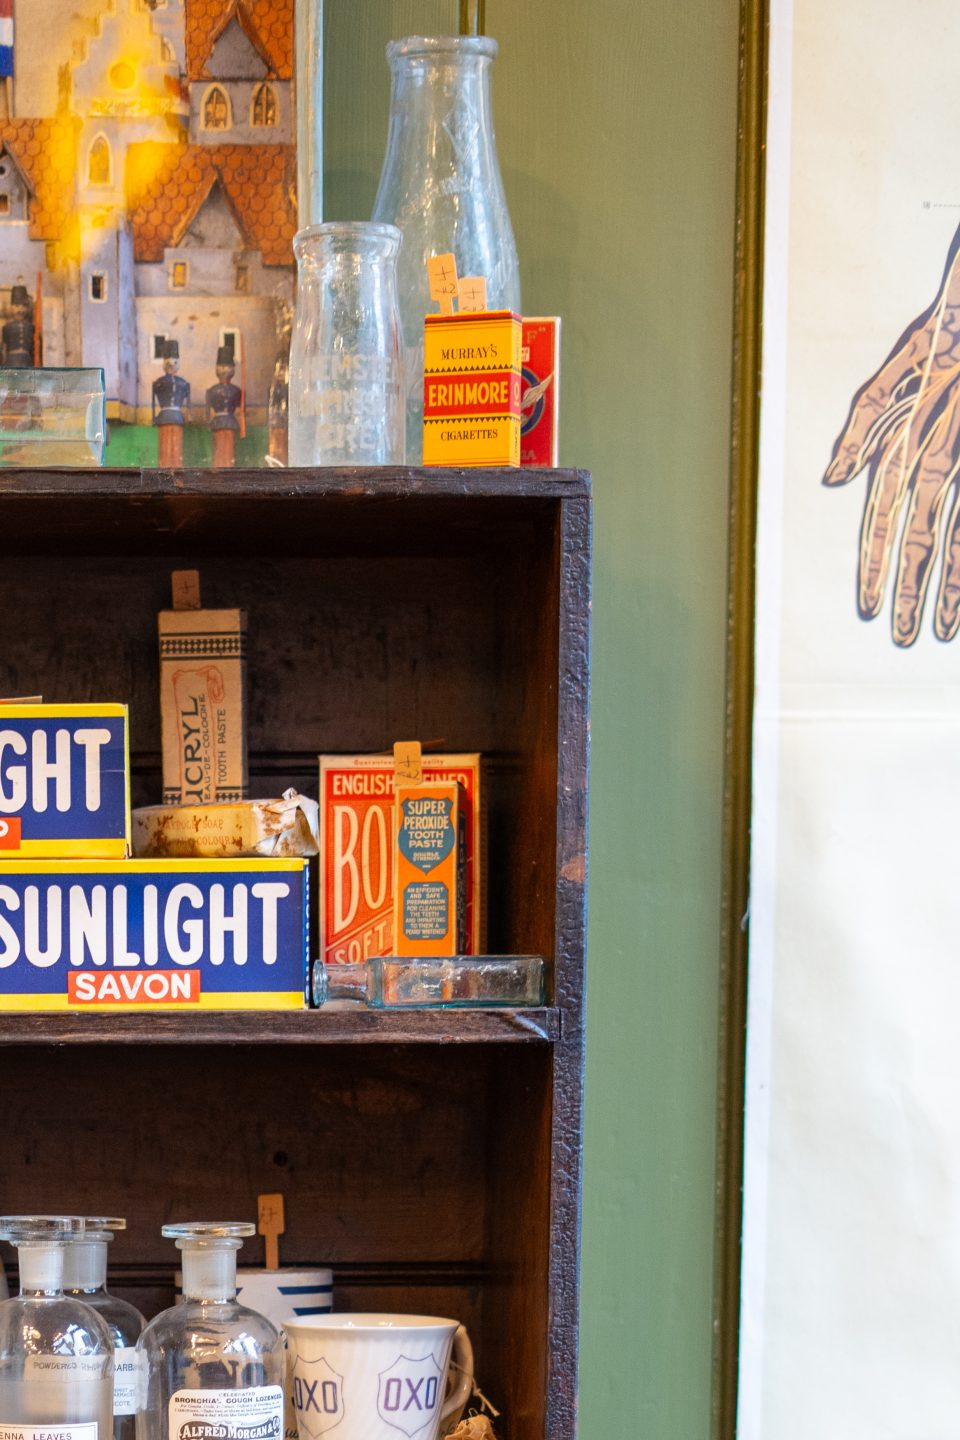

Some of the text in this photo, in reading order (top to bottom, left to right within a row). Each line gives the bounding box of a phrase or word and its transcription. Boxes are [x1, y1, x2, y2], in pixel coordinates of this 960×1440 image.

[441, 344, 498, 360] MURRAY'S
[428, 381, 509, 407] ERINMORE
[440, 429, 498, 441] CIGARETTES
[217, 708, 227, 784] TOOTH PASTE
[333, 774, 395, 796] ENGLISH
[408, 801, 445, 815] SUPER
[404, 816, 449, 829] PEROXIDE
[408, 831, 444, 839] TOOTH
[409, 840, 443, 848] PASTE
[75, 972, 192, 1001] SAVON
[292, 1377, 338, 1414] OXO
[383, 1376, 438, 1412] OXO
[33, 1432, 72, 1440] LEAVES
[182, 1425, 226, 1439] ALFRED
[227, 1425, 267, 1439] MORGAN
